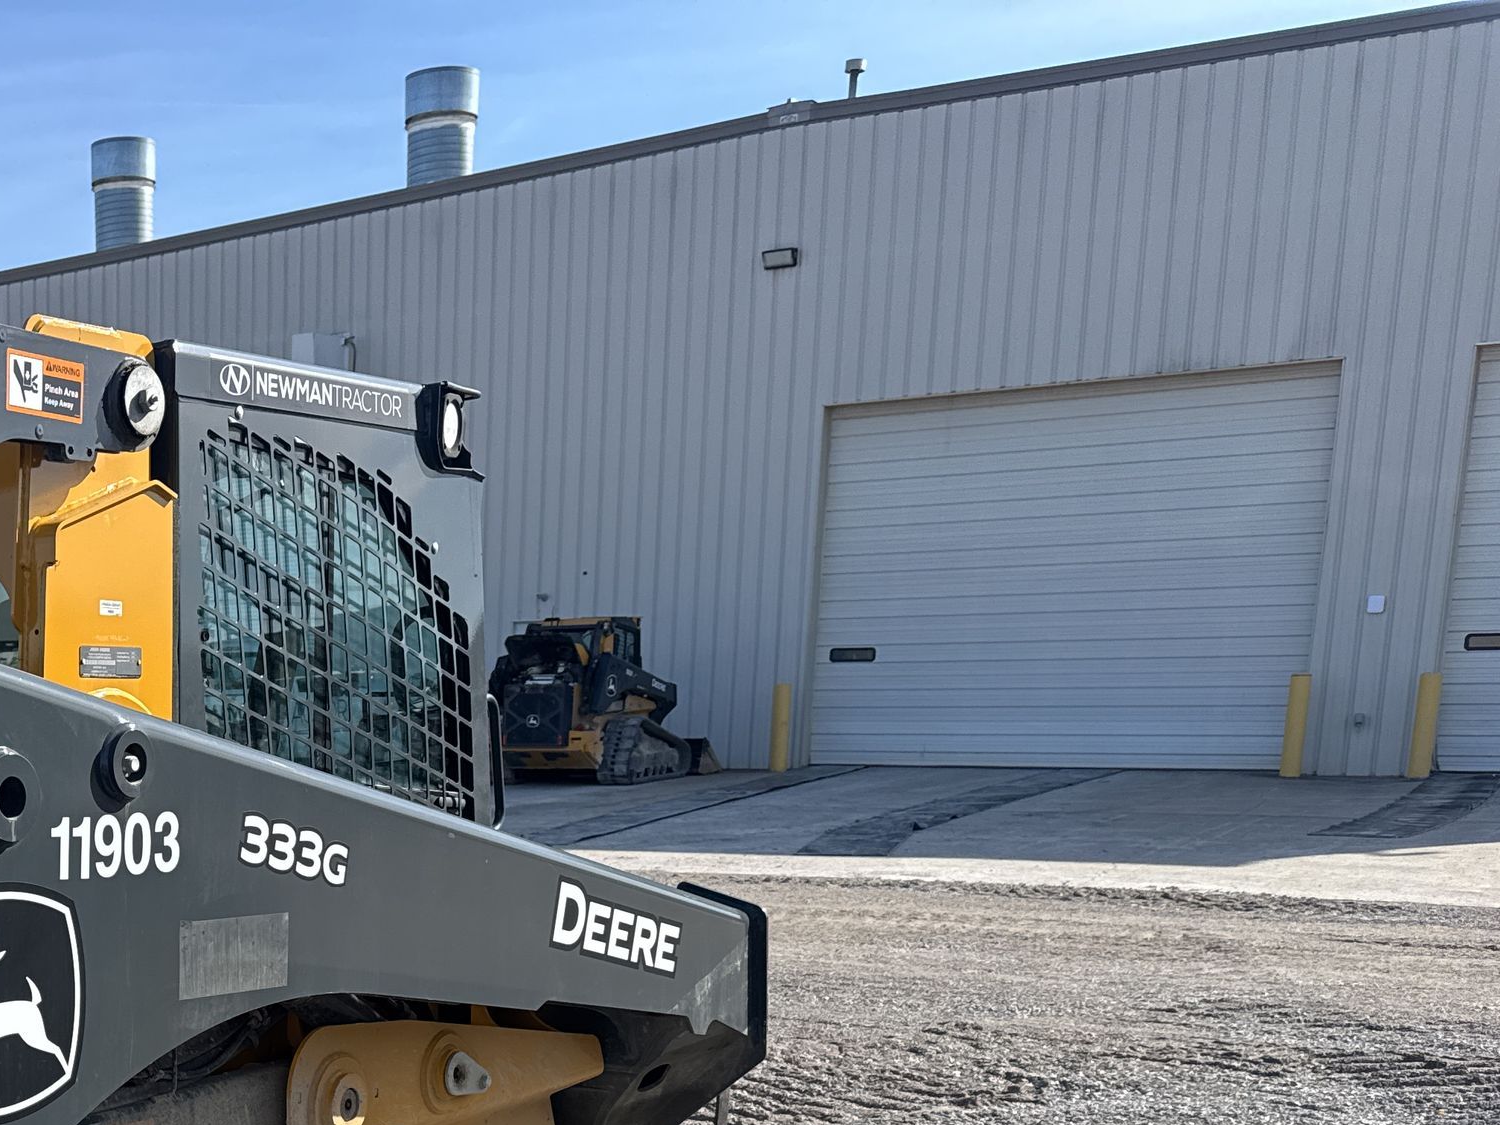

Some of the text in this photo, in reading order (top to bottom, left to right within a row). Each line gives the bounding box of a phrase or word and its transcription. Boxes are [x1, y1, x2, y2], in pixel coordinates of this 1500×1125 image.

[44, 383, 79, 399] Pinch Area
[52, 364, 80, 378] WARNING
[44, 396, 74, 411] Keep Away
[51, 811, 180, 880] 11903
[239, 814, 349, 886] 333G
[552, 881, 681, 973] DEERE
